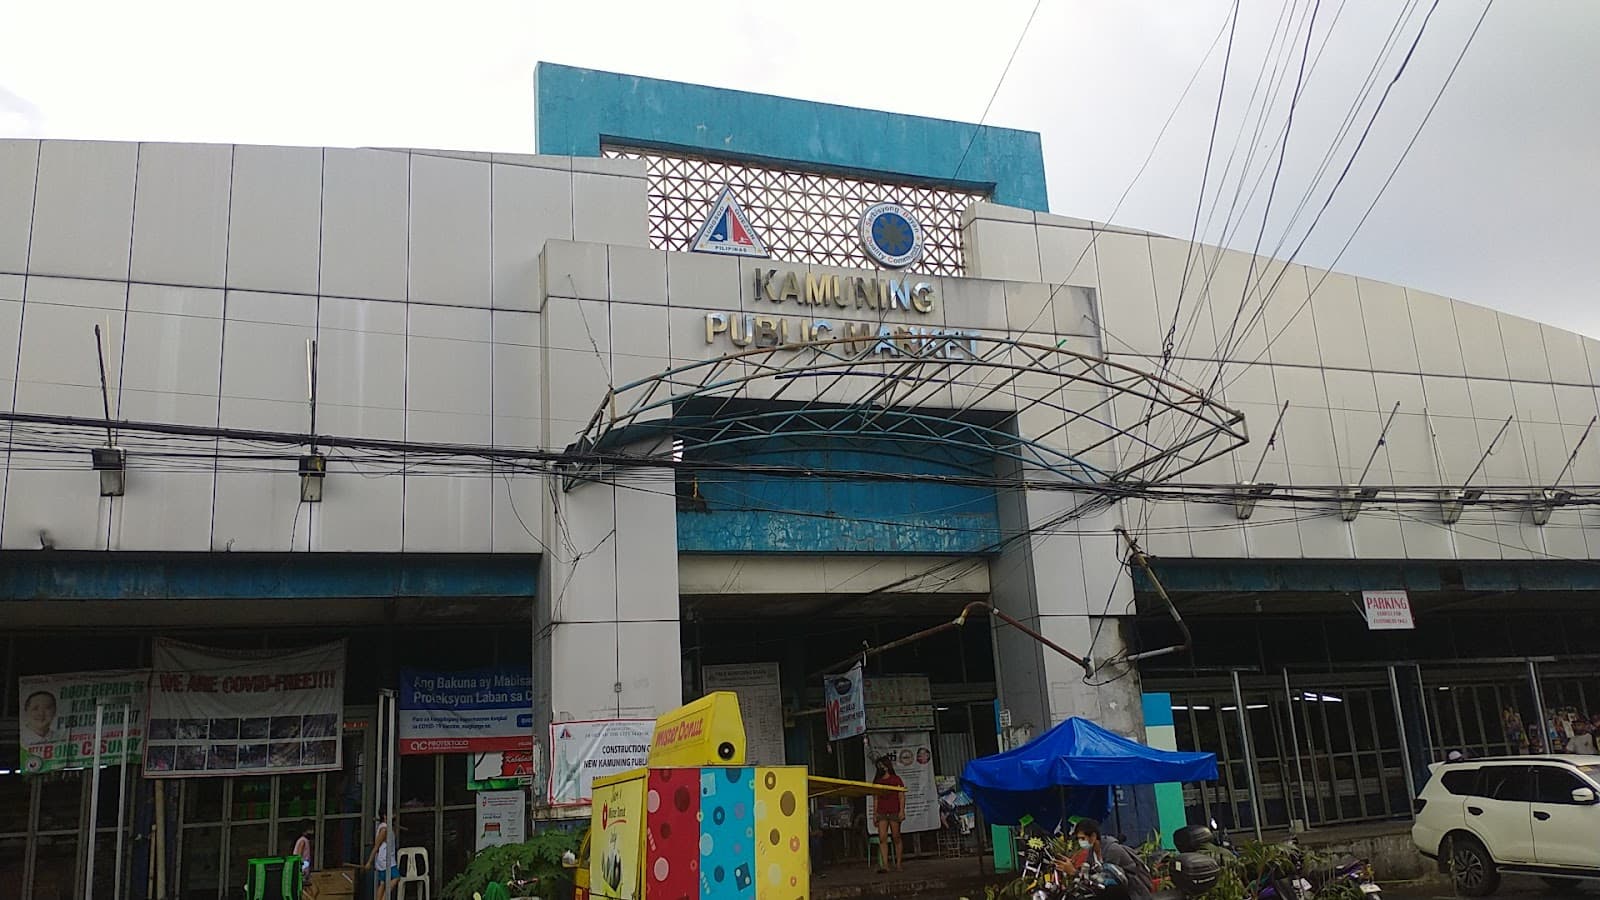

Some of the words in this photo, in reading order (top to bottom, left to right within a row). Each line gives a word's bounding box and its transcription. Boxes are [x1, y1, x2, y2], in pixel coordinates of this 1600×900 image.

[753, 268, 935, 314] KAMUNING
[705, 312, 833, 350] PUBLIC
[843, 321, 982, 360] MARKET
[1366, 596, 1408, 610] PARKING
[159, 671, 184, 693] WE
[186, 673, 218, 693] ARE
[414, 676, 435, 690] Ang
[437, 676, 477, 689] Bakuna
[479, 678, 492, 690] ay
[494, 674, 532, 687] Mabisa
[413, 691, 473, 707] Proteksyon
[476, 690, 508, 703] Laban
[510, 690, 523, 701] sa
[102, 710, 141, 726] MARET
[826, 700, 840, 737] NO
[43, 743, 79, 759] BONG
[100, 737, 142, 756] SUNAY
[601, 744, 646, 754] CONSTRUCTION
[583, 759, 598, 769] NEW
[598, 759, 631, 768] KAMUNING
[632, 758, 647, 767] PUBLI
